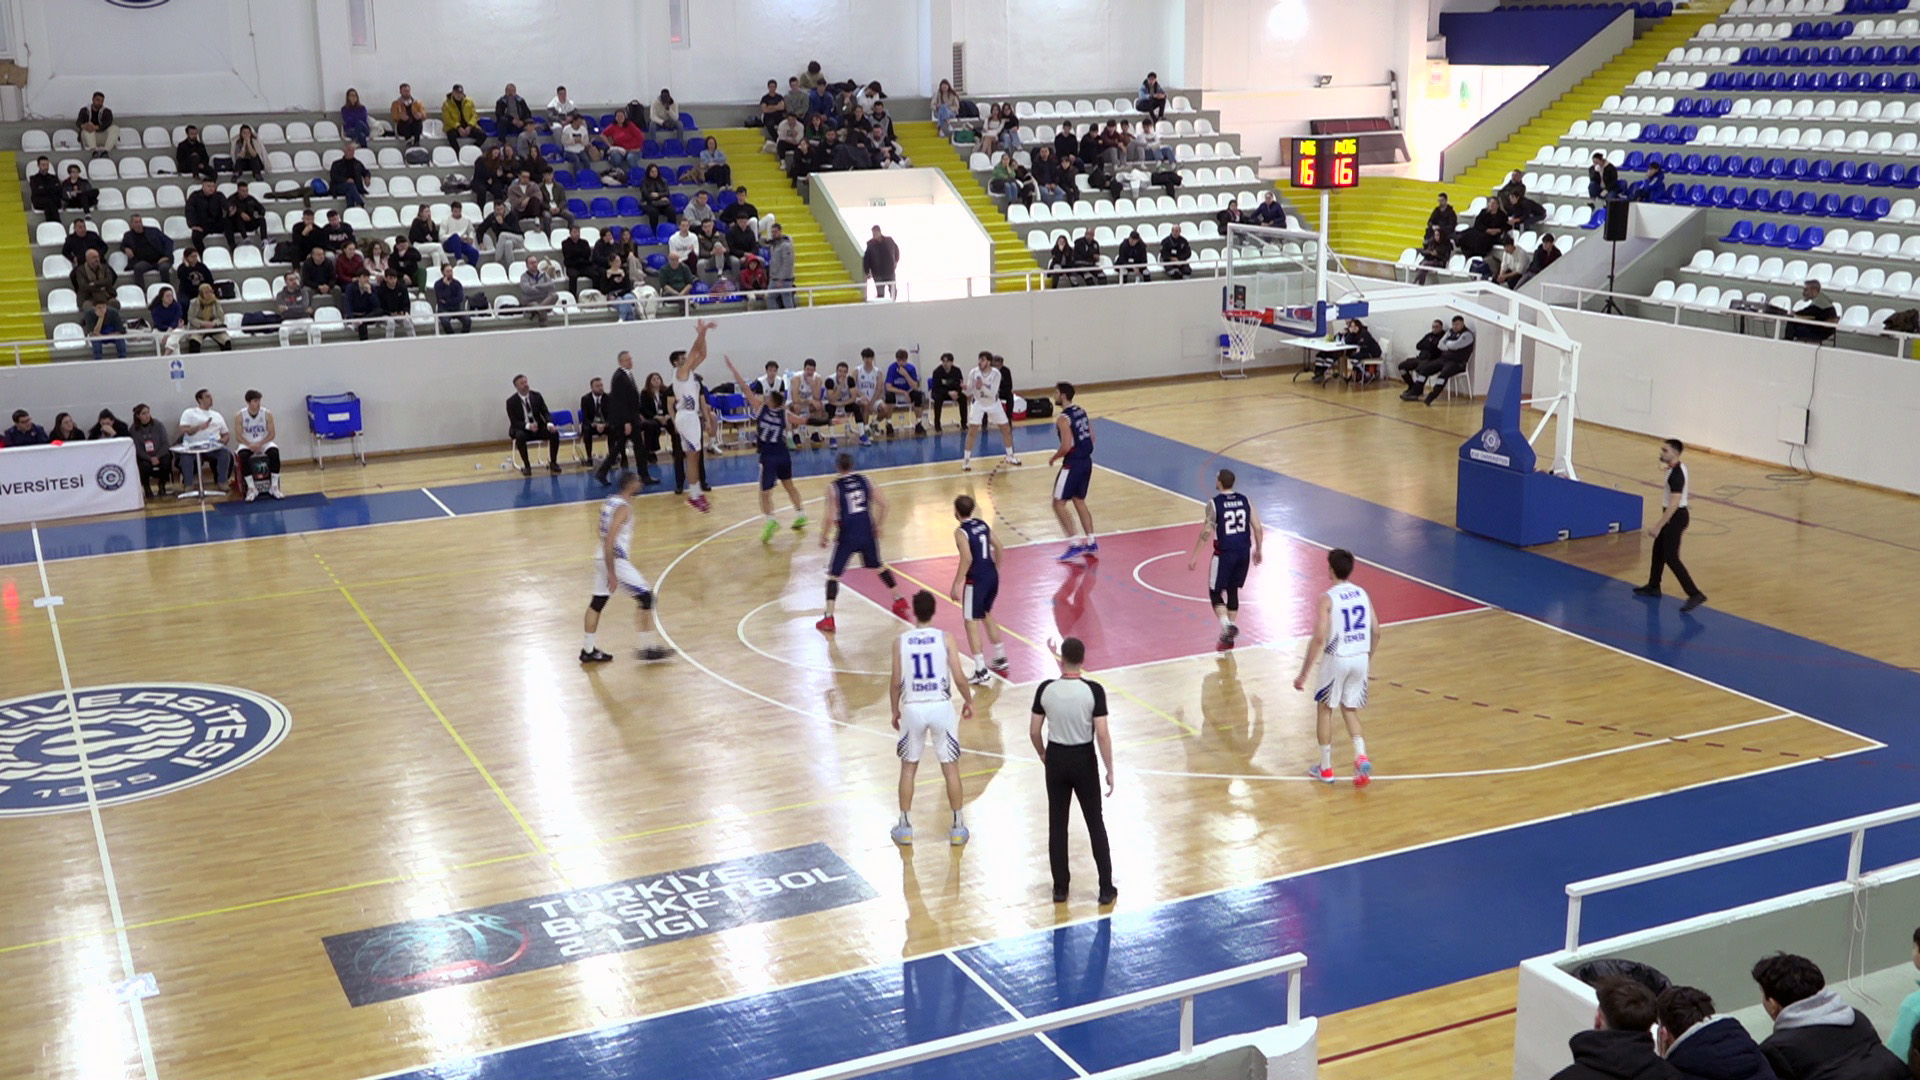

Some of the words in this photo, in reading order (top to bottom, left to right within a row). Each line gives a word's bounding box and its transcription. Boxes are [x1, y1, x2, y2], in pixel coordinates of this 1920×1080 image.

[1300, 158, 1315, 186] 16
[1334, 157, 1353, 186] 16
[760, 421, 781, 443] 77
[1223, 509, 1246, 535] 23
[979, 533, 988, 560] 1
[1341, 604, 1366, 633] 12
[911, 652, 936, 679] 11
[541, 867, 847, 938] BASKETBOL
